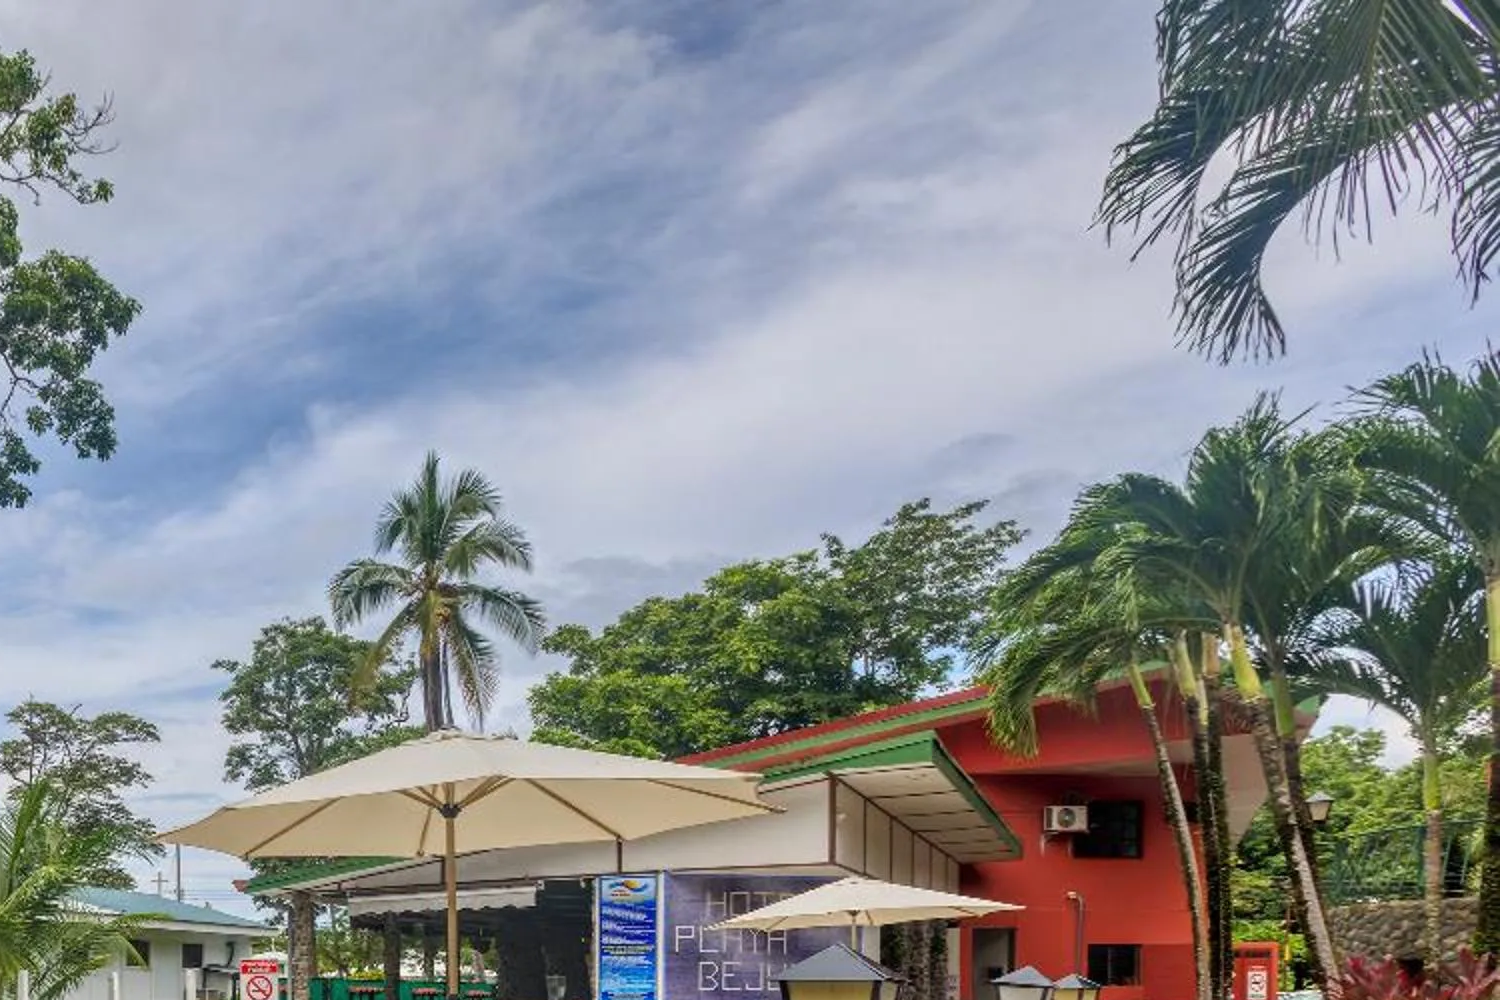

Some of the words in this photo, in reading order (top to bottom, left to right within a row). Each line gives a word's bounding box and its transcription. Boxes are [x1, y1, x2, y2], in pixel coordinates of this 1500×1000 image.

[706, 891, 797, 919] HOT
[675, 924, 788, 954] PLAYA
[698, 961, 788, 991] BEJU
